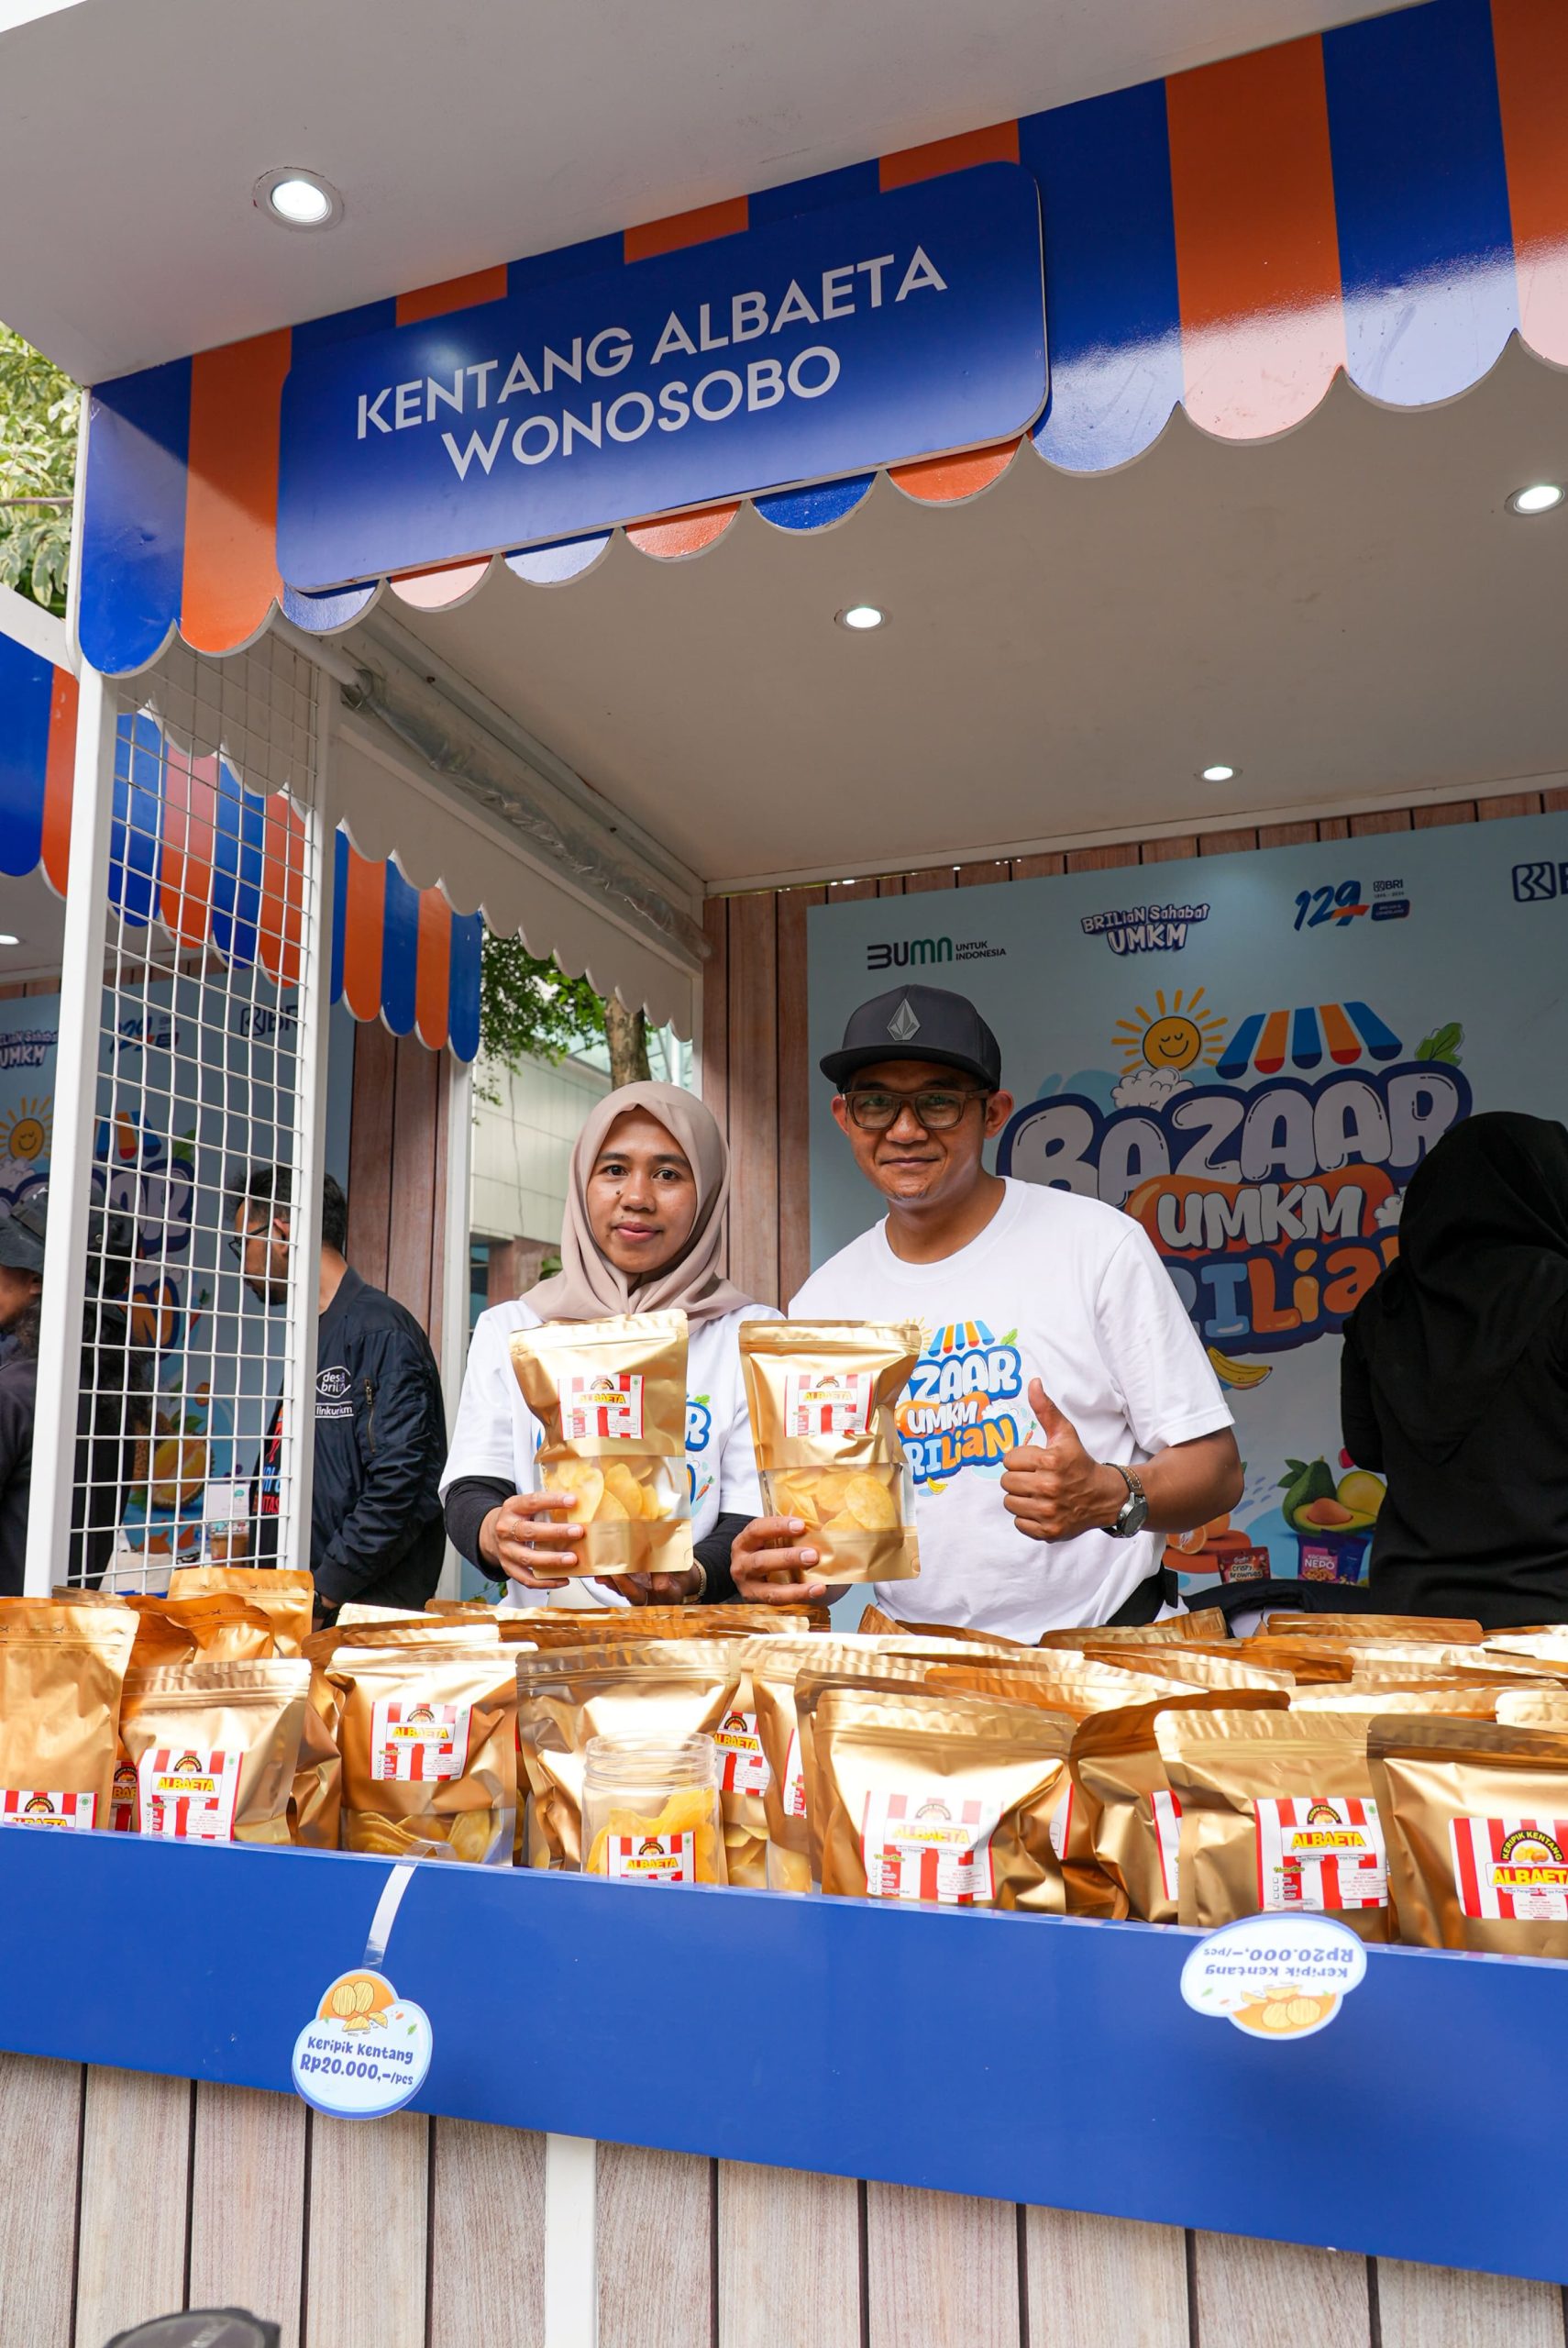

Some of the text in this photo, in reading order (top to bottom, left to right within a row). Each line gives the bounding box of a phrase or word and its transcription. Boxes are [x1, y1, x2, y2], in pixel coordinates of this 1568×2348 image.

[357, 245, 948, 439] KENTANG ALBAETA
[441, 346, 841, 482] WONOSOBO
[1148, 903, 1210, 923] Sahabat
[1294, 880, 1363, 931] 129
[955, 940, 988, 952] UNTUK
[1107, 923, 1188, 954] UMKM
[955, 948, 1007, 961] INDONESIA
[1009, 1071, 1460, 1207] BAZAAR
[1156, 1182, 1364, 1249] UMKM
[896, 1351, 1018, 1406] ZAAR
[907, 1401, 978, 1434] UMKM
[902, 1418, 1014, 1477] RILiaN
[1305, 1559, 1335, 1570] NEPO
[157, 1777, 215, 1792] ALBAETA
[892, 1823, 971, 1845] ALBAETA
[1290, 1831, 1367, 1850] ALBAETA
[1502, 1831, 1563, 1861] KERIPIK KENTANG
[625, 1857, 679, 1870] ALBAETA
[1493, 1866, 1568, 1886] ALBAET
[1204, 1964, 1348, 1978] Keripik Kentang
[307, 2036, 414, 2066] Keripik Kentang
